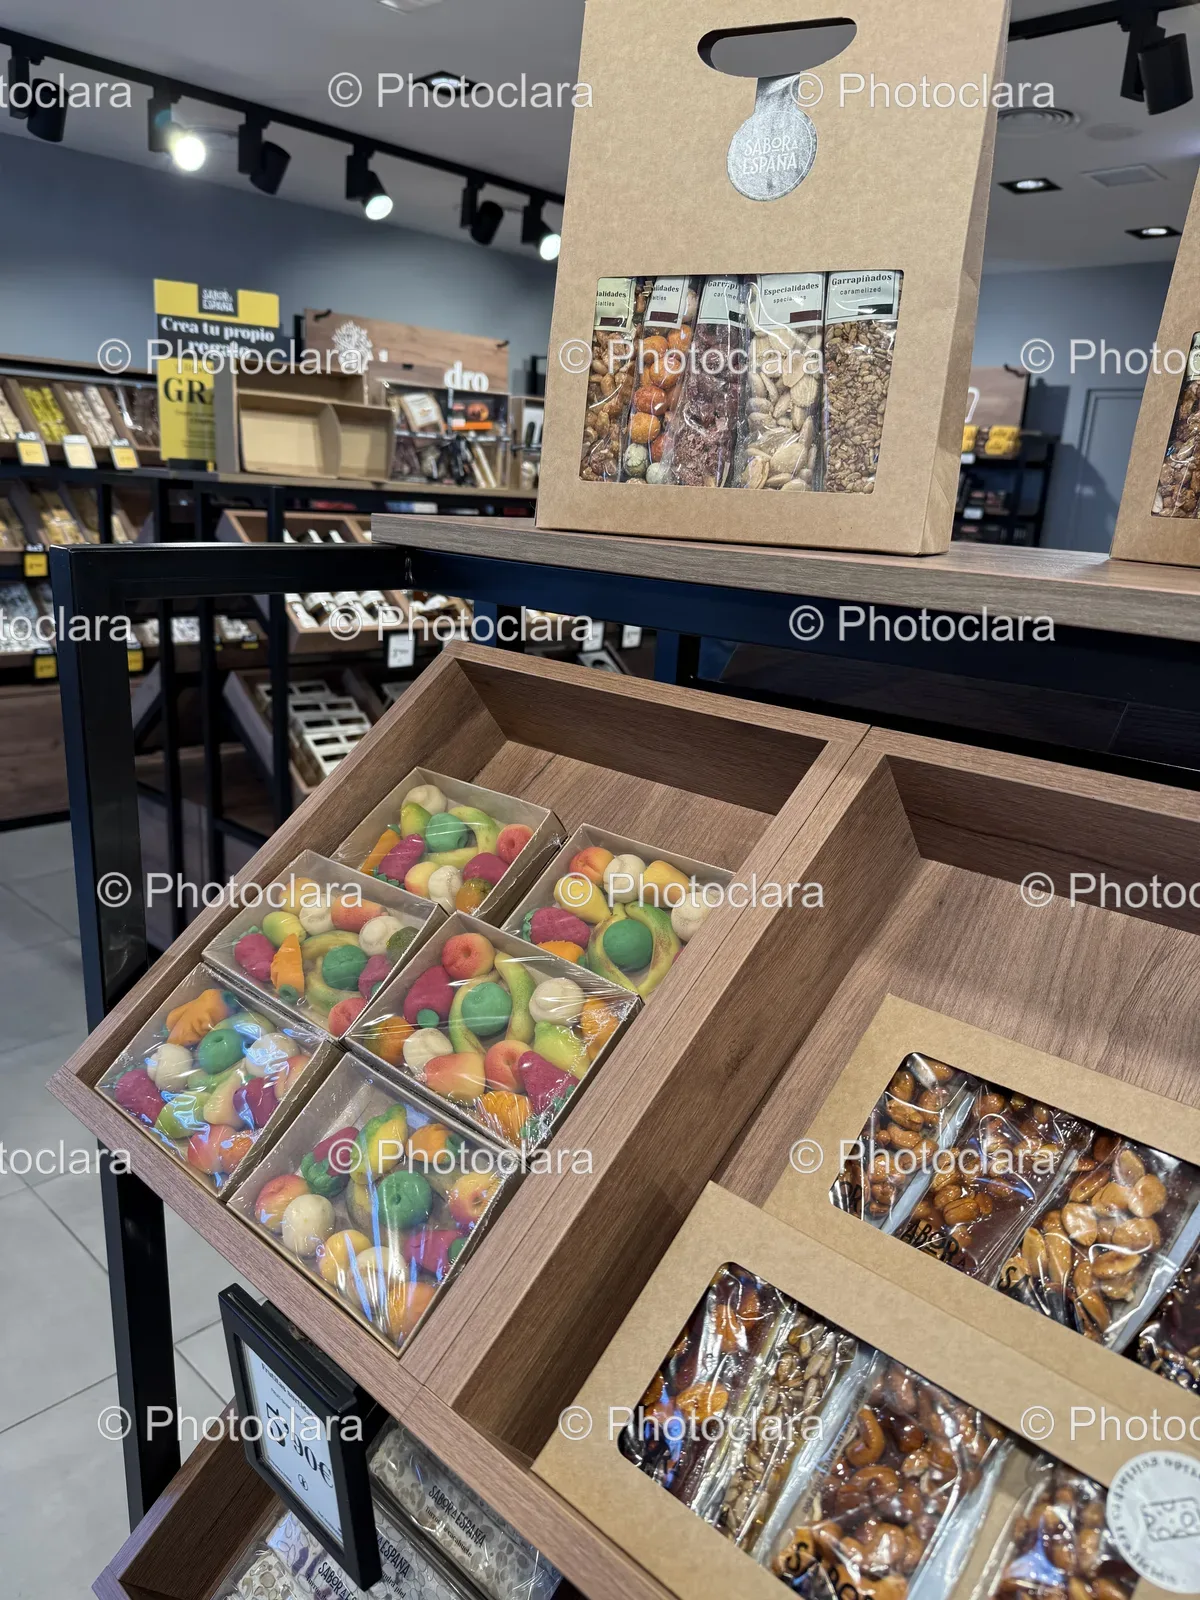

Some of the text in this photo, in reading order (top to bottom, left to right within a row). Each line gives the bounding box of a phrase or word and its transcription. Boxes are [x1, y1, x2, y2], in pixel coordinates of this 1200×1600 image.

[743, 152, 797, 174] ESPAÑA
[764, 282, 820, 296] Especialidades
[832, 273, 892, 286] Garrapiñados
[840, 286, 882, 296] caramelized
[160, 316, 276, 344] Crea tu propio
[428, 1485, 454, 1516] SABOR
[455, 1511, 486, 1548] ESPAÑA
[380, 1540, 410, 1578] ESPAÑA
[318, 1562, 344, 1595] SABOR
